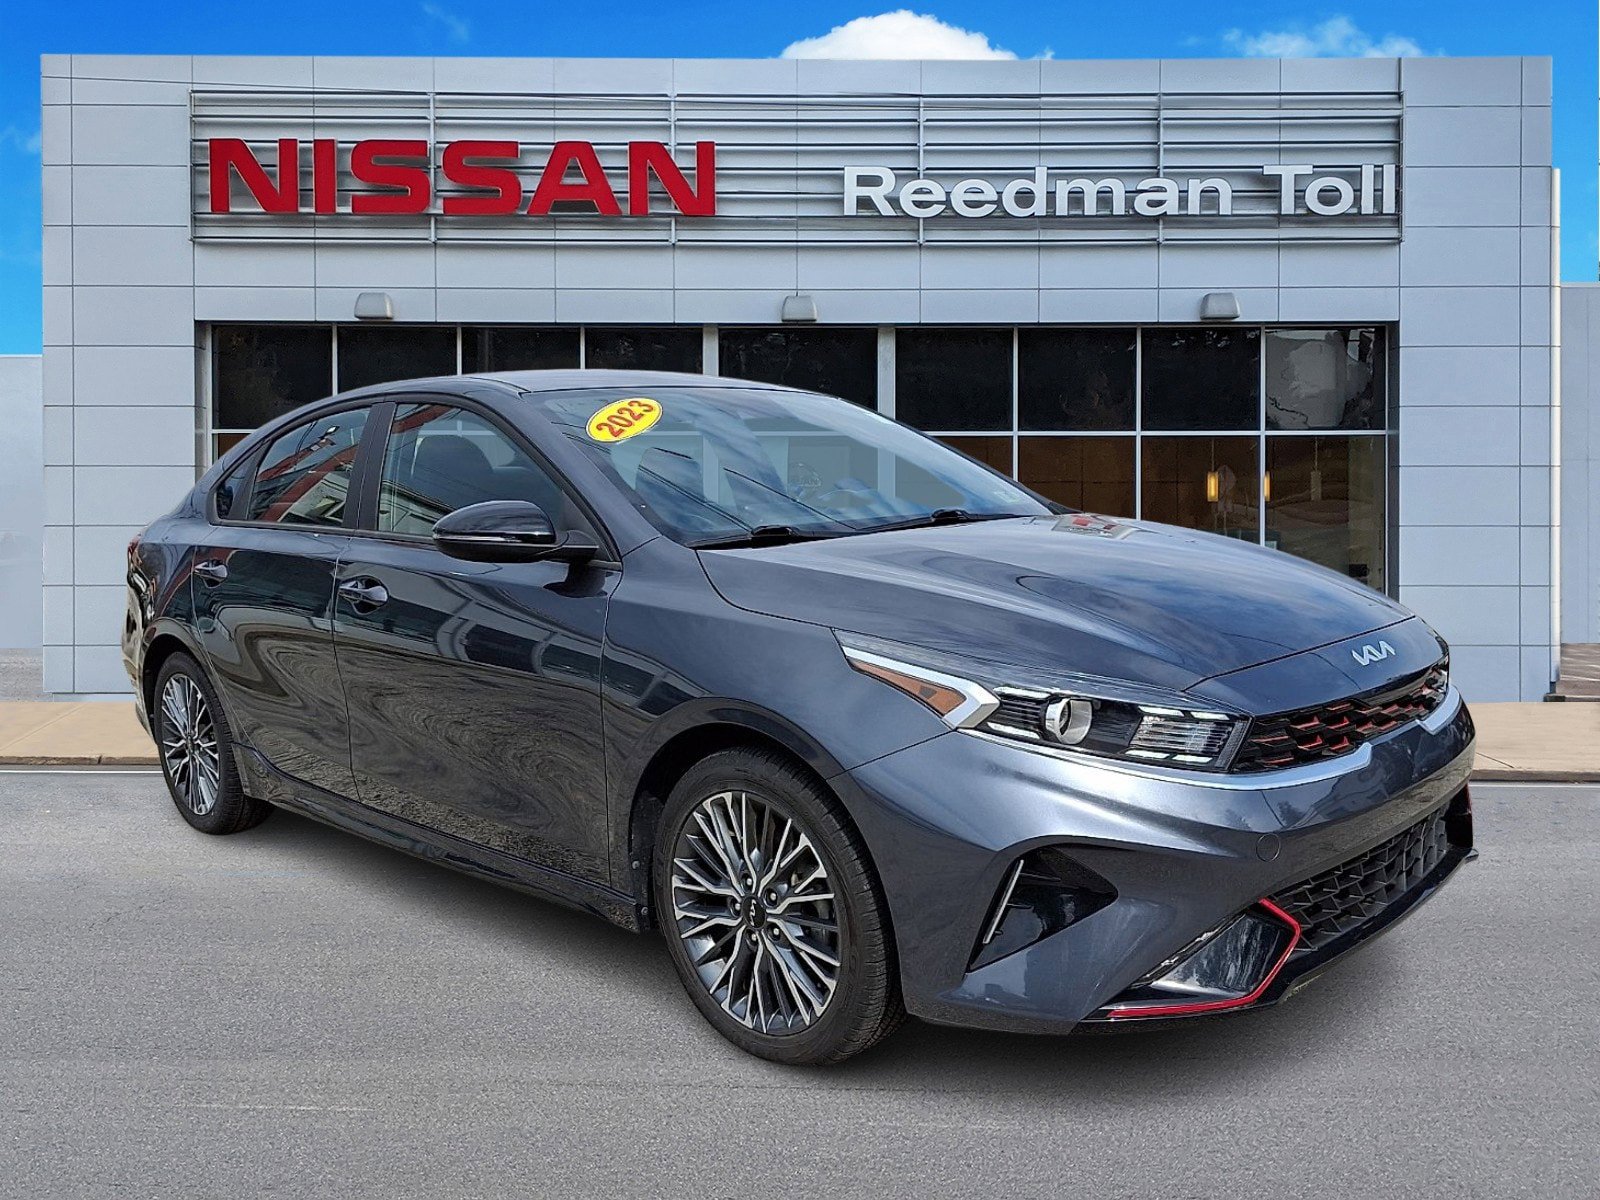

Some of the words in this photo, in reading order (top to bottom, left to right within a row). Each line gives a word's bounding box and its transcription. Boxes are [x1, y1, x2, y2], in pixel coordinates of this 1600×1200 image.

[209, 138, 716, 217] NISSAN
[843, 165, 1232, 218] Reedman
[1263, 163, 1397, 216] Toll
[596, 400, 654, 438] 2023
